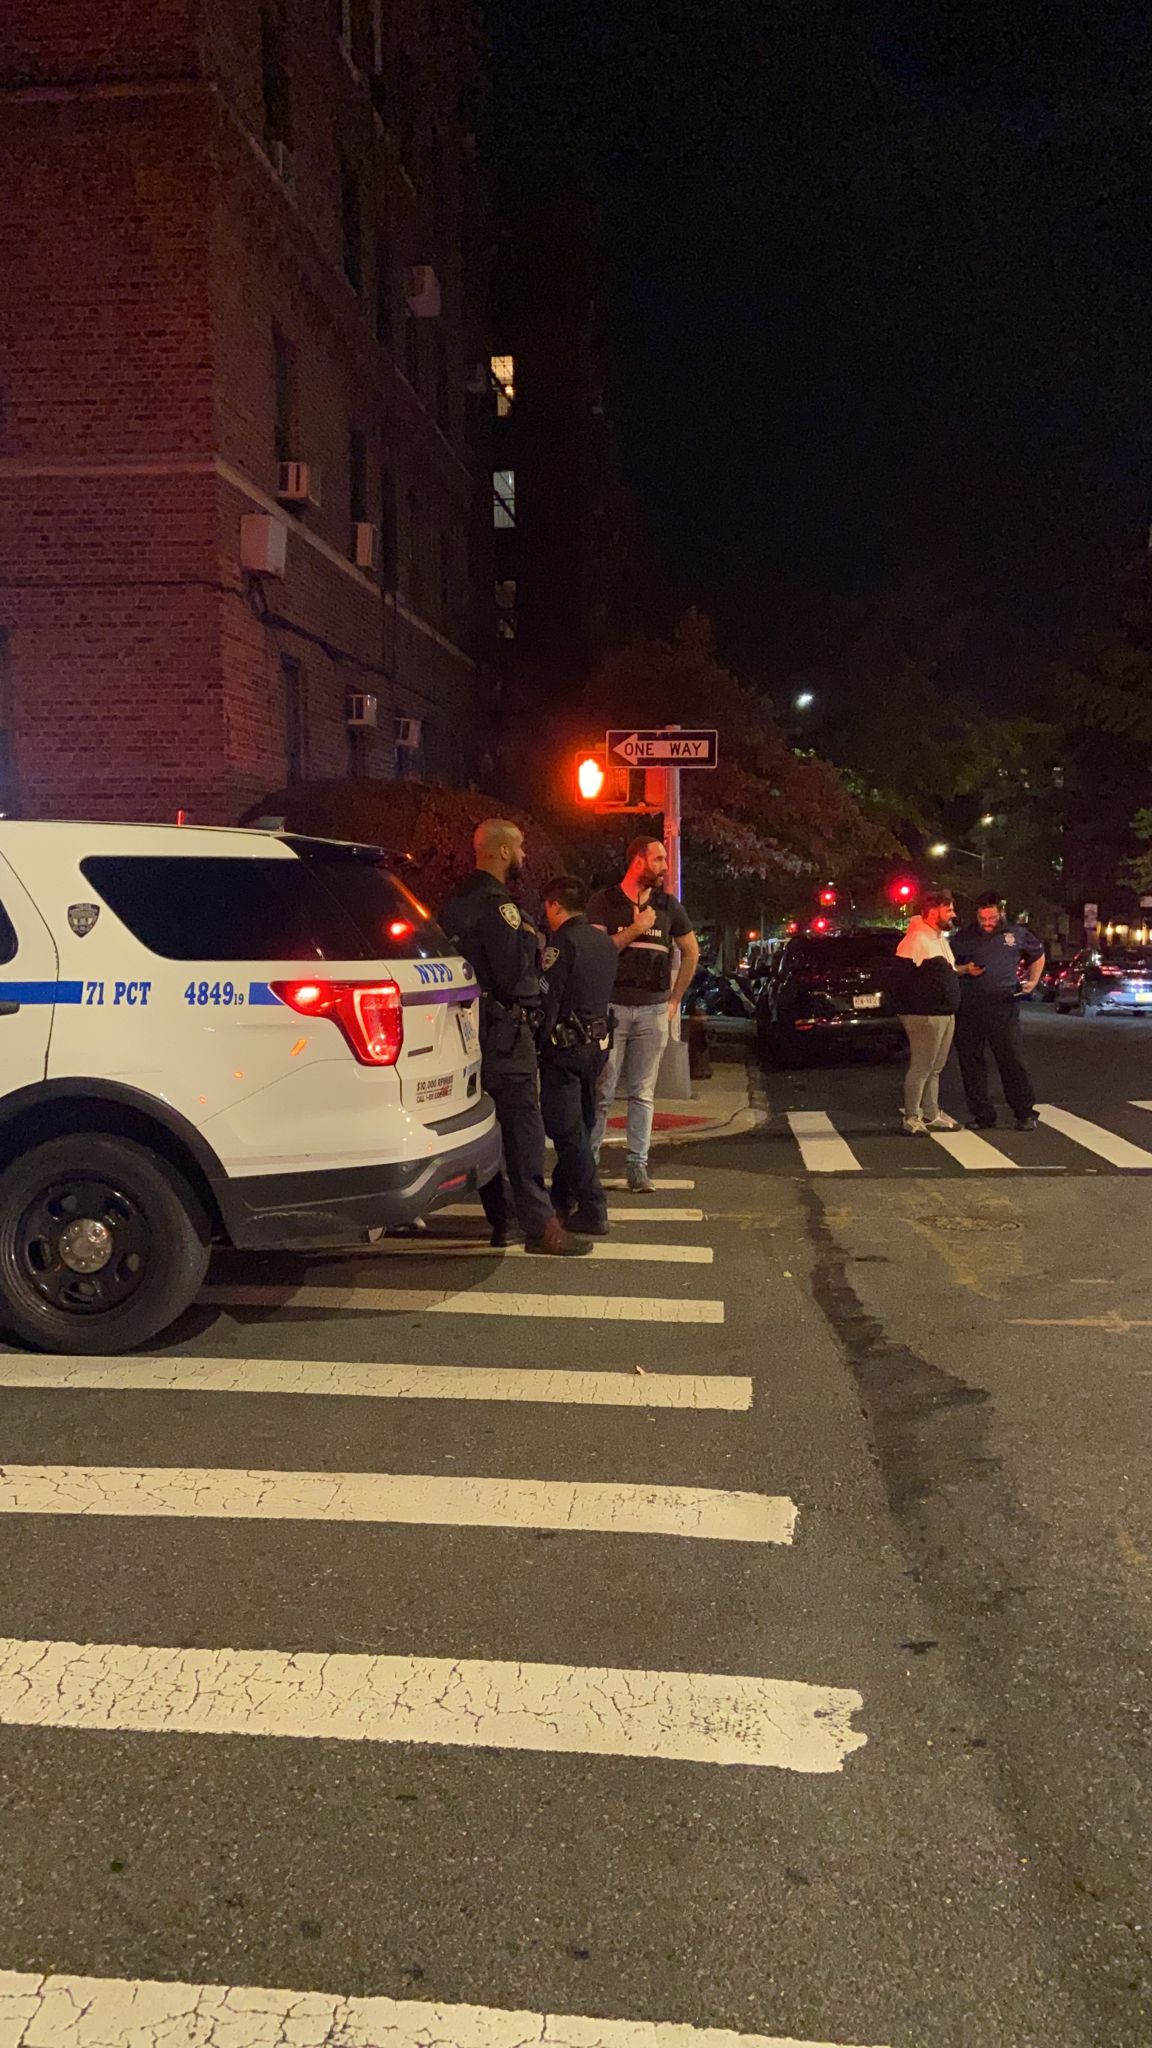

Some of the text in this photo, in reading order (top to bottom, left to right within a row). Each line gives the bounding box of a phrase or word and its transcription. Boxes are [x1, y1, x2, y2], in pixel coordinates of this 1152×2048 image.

[624, 742, 702, 756] ONE WAY
[413, 963, 453, 984] NYPD
[86, 981, 152, 1005] 71 PCT
[184, 981, 234, 1006] 4849
